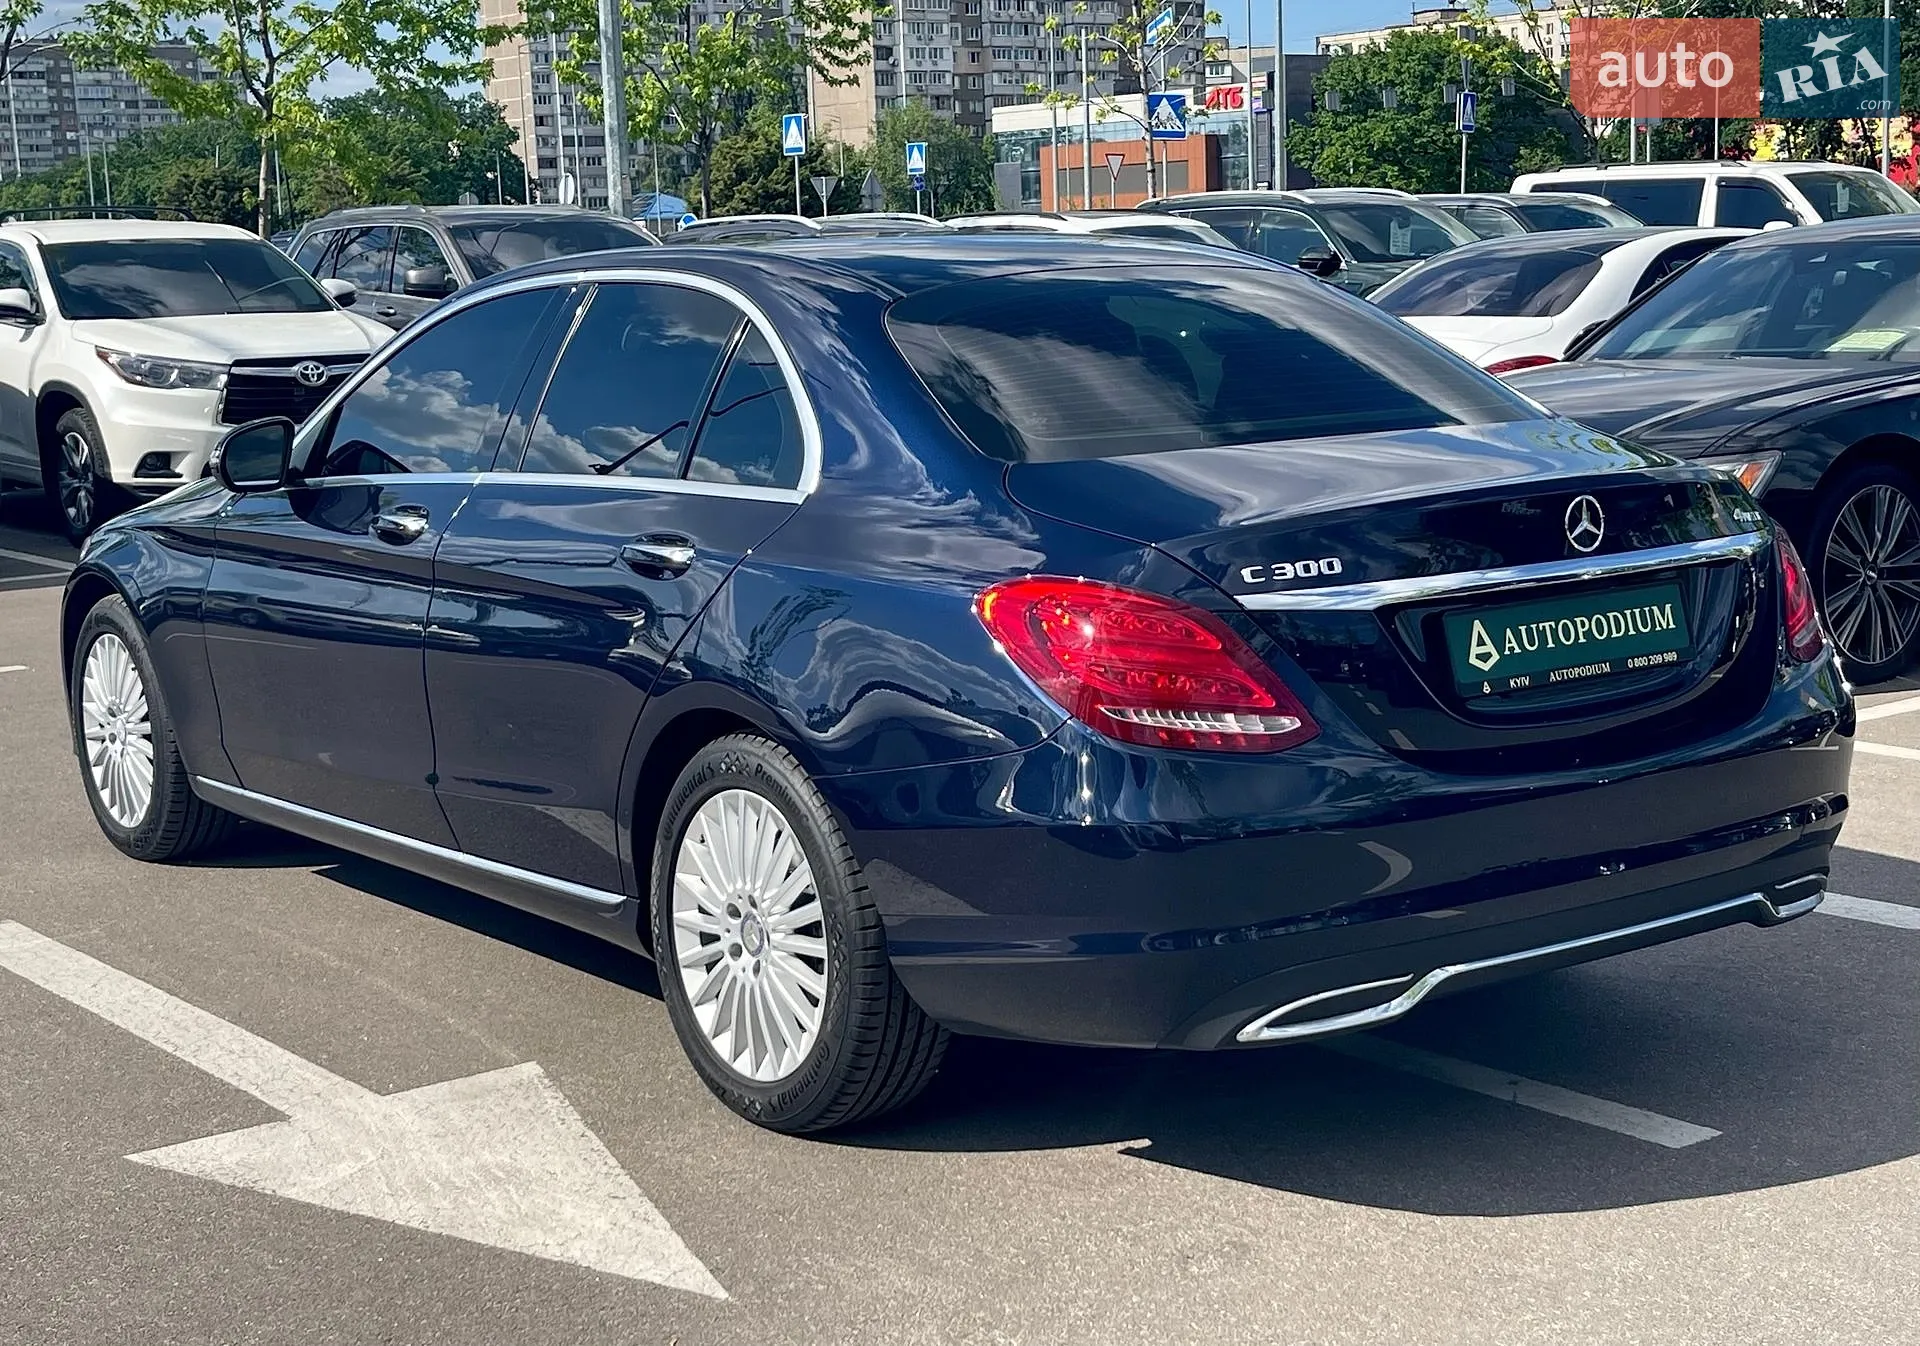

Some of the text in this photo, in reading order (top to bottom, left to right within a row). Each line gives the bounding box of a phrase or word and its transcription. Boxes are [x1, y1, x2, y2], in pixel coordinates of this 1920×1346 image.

[1240, 557, 1343, 584] C 300
[1503, 603, 1676, 656] AUTOPODIUM
[1509, 675, 1530, 689] KYIV
[1549, 662, 1611, 683] AUTOPODIUM
[1633, 656, 1648, 668] 800
[1648, 653, 1663, 665] 209
